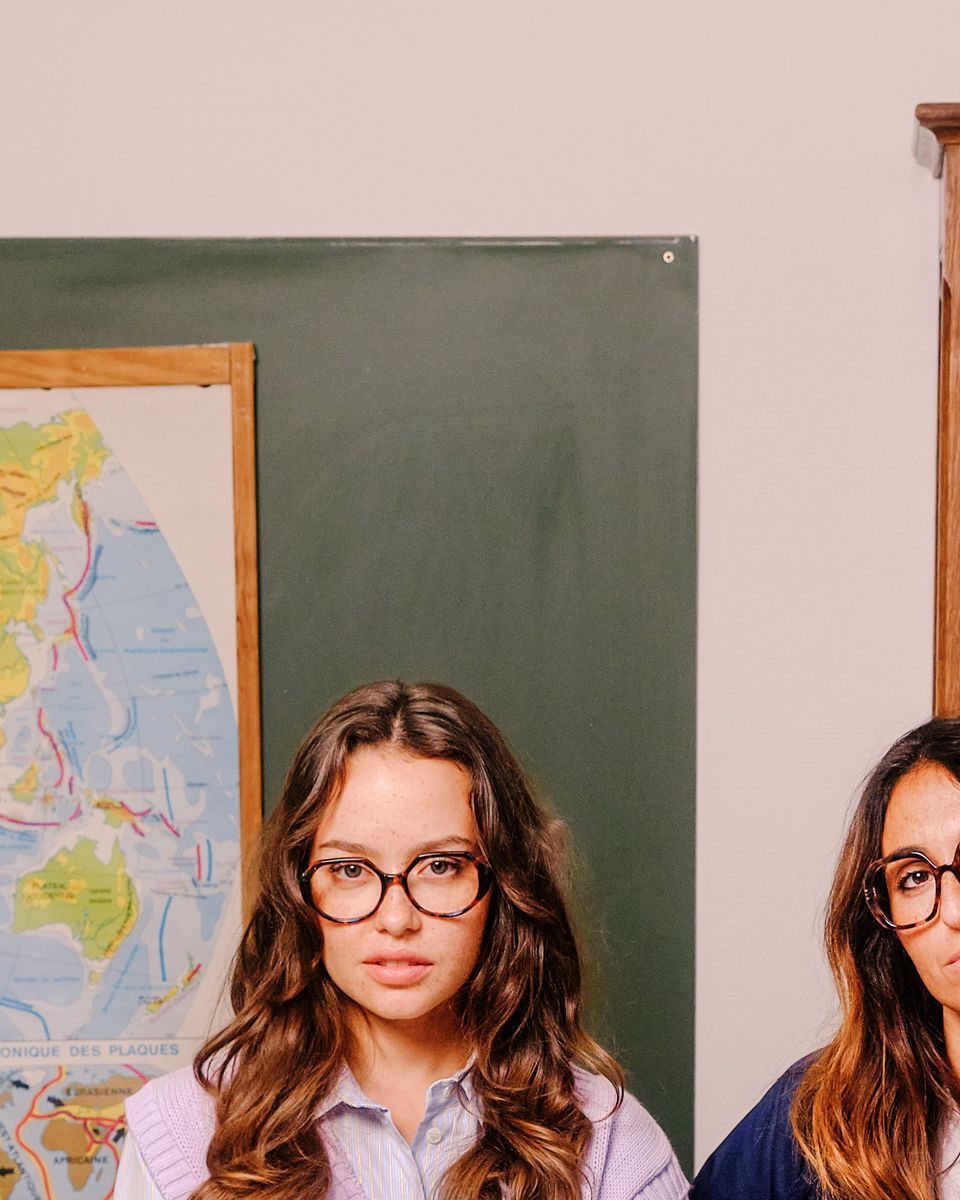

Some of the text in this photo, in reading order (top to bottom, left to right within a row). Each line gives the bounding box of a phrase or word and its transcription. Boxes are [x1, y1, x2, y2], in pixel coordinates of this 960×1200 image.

[0, 1043, 179, 1058] ONIQUE DES PLAQUES
[53, 1156, 108, 1164] AFRICAINE
